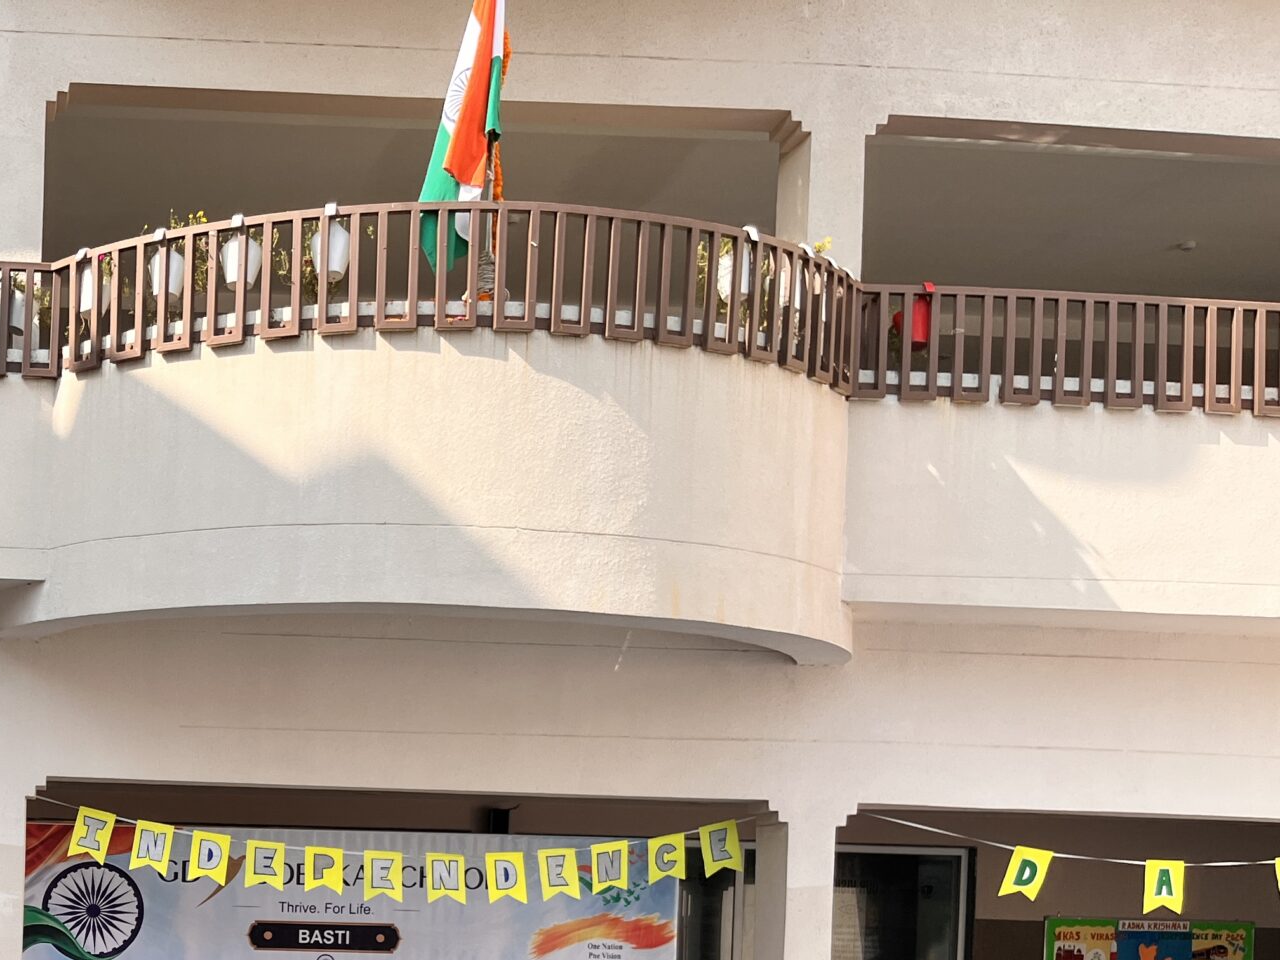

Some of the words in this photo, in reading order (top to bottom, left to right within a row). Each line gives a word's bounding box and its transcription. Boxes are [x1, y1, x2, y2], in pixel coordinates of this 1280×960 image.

[278, 901, 321, 915] Thrive.
[325, 902, 346, 915] For
[349, 903, 374, 916] Life.
[298, 929, 350, 946] BASTI
[587, 942, 601, 950] One
[602, 942, 624, 950] Nation
[602, 952, 622, 960] Vision
